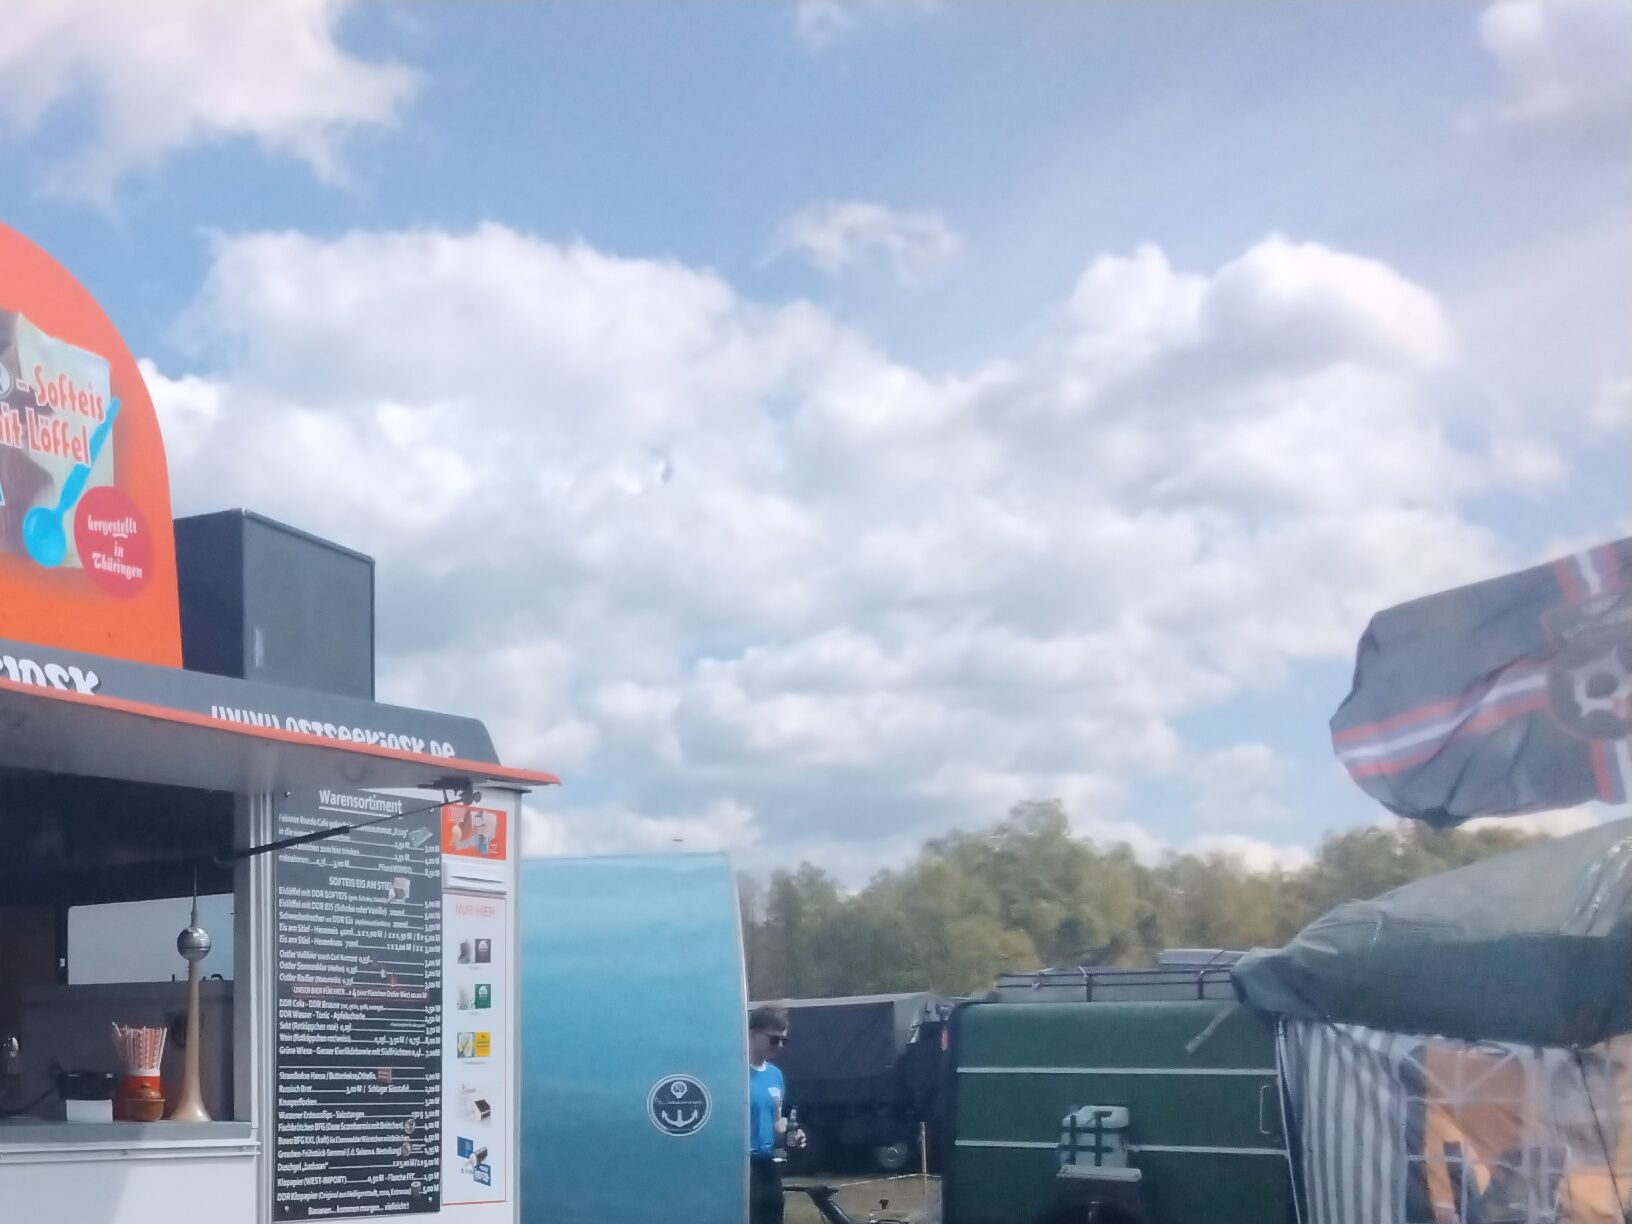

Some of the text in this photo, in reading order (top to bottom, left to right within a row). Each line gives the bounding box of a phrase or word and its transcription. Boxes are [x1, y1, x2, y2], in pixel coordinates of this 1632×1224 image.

[34, 365, 105, 423] Softeis
[26, 407, 92, 468] Löffel
[87, 514, 138, 538] hergestellt
[113, 541, 124, 557] in
[91, 550, 143, 580] Thüringen
[319, 789, 403, 814] Warensortiment
[377, 881, 392, 890] STIE
